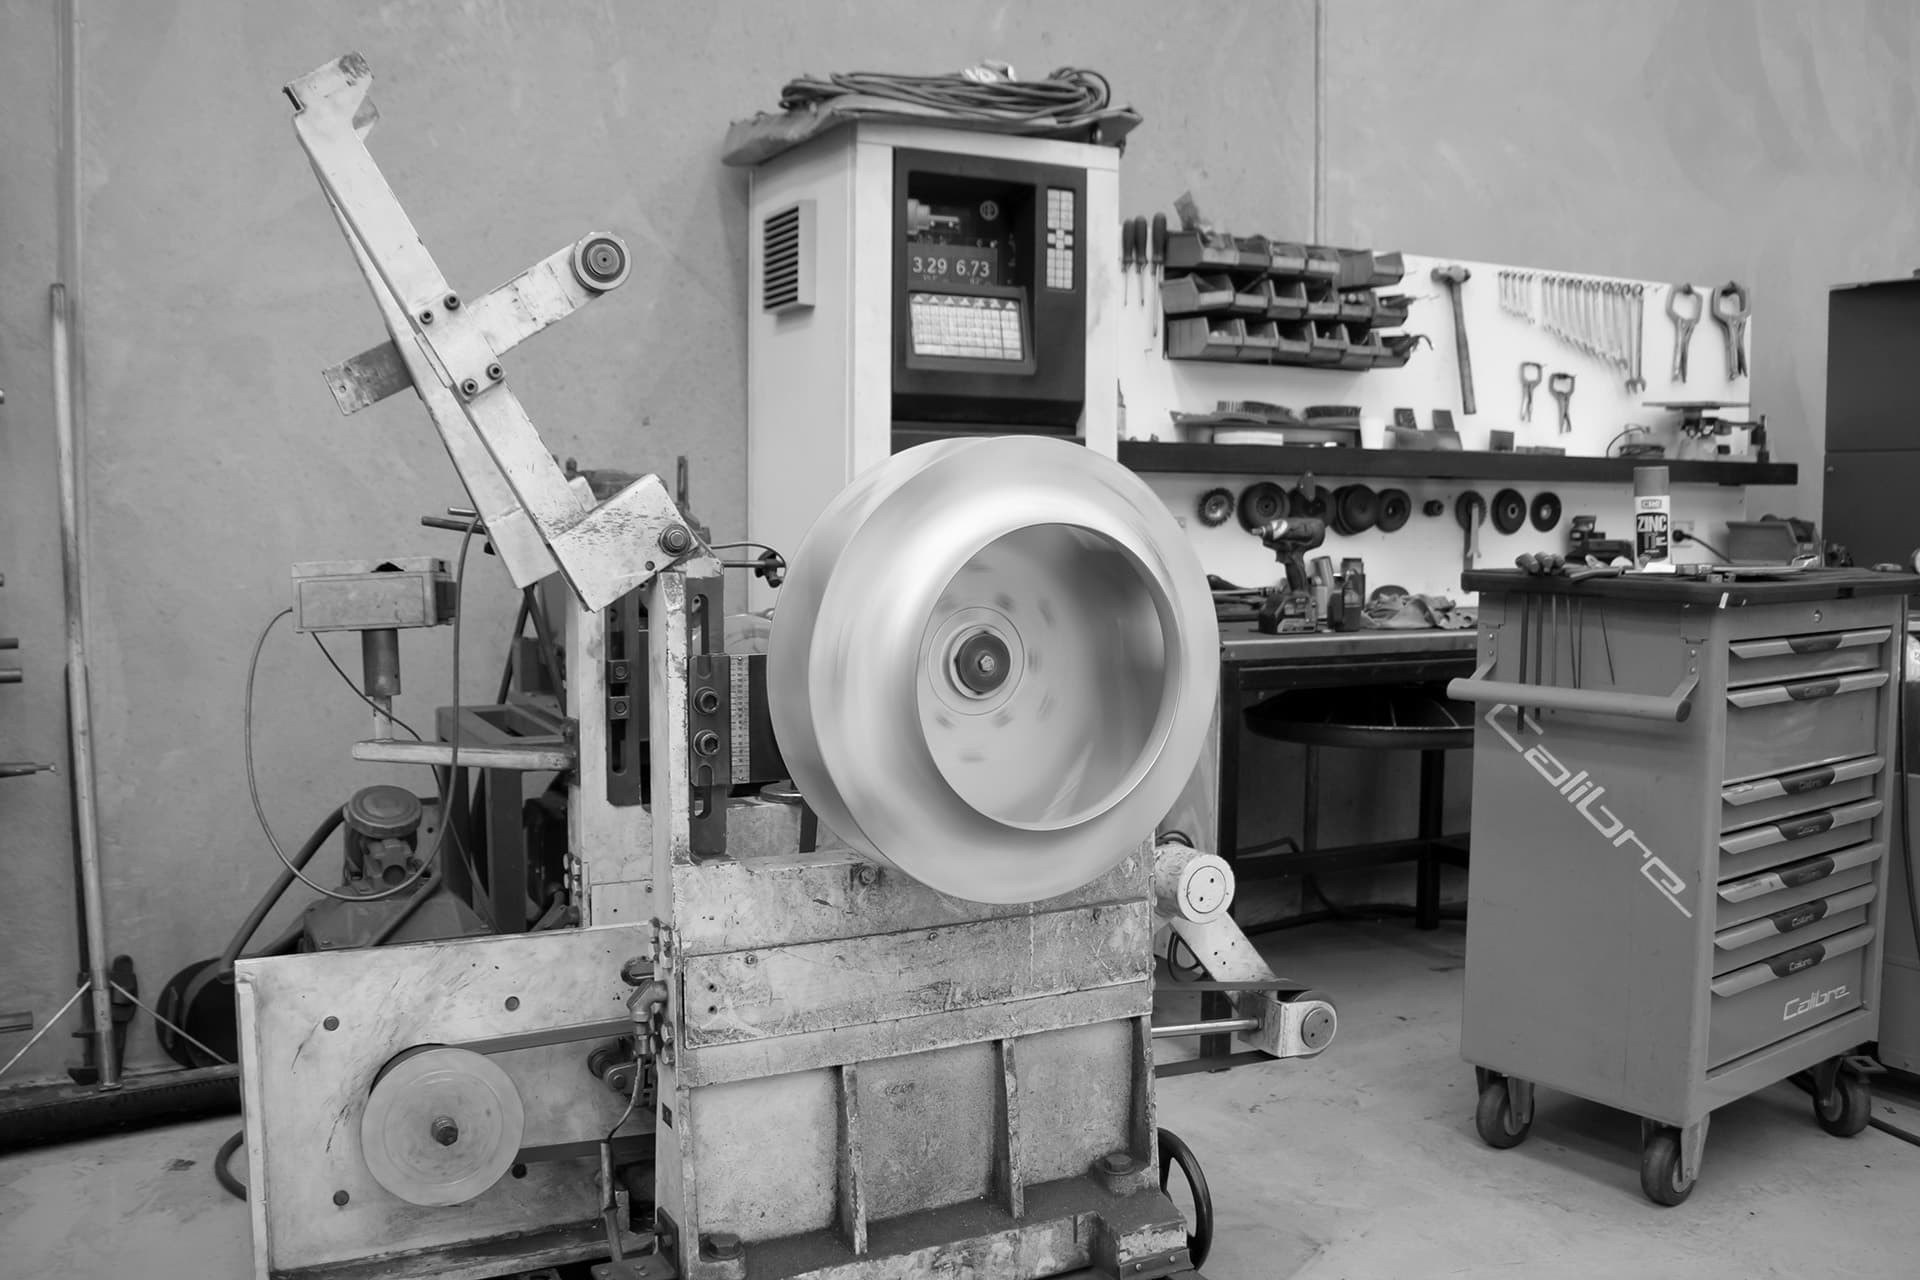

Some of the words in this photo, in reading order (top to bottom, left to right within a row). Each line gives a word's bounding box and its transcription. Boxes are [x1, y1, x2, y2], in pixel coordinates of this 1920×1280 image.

[912, 256, 948, 275] 3.29
[956, 259, 990, 278] 6.73
[1637, 514, 1668, 532] ZINC
[1484, 703, 1693, 918] Calibre
[1783, 985, 1850, 1021] Calibre
